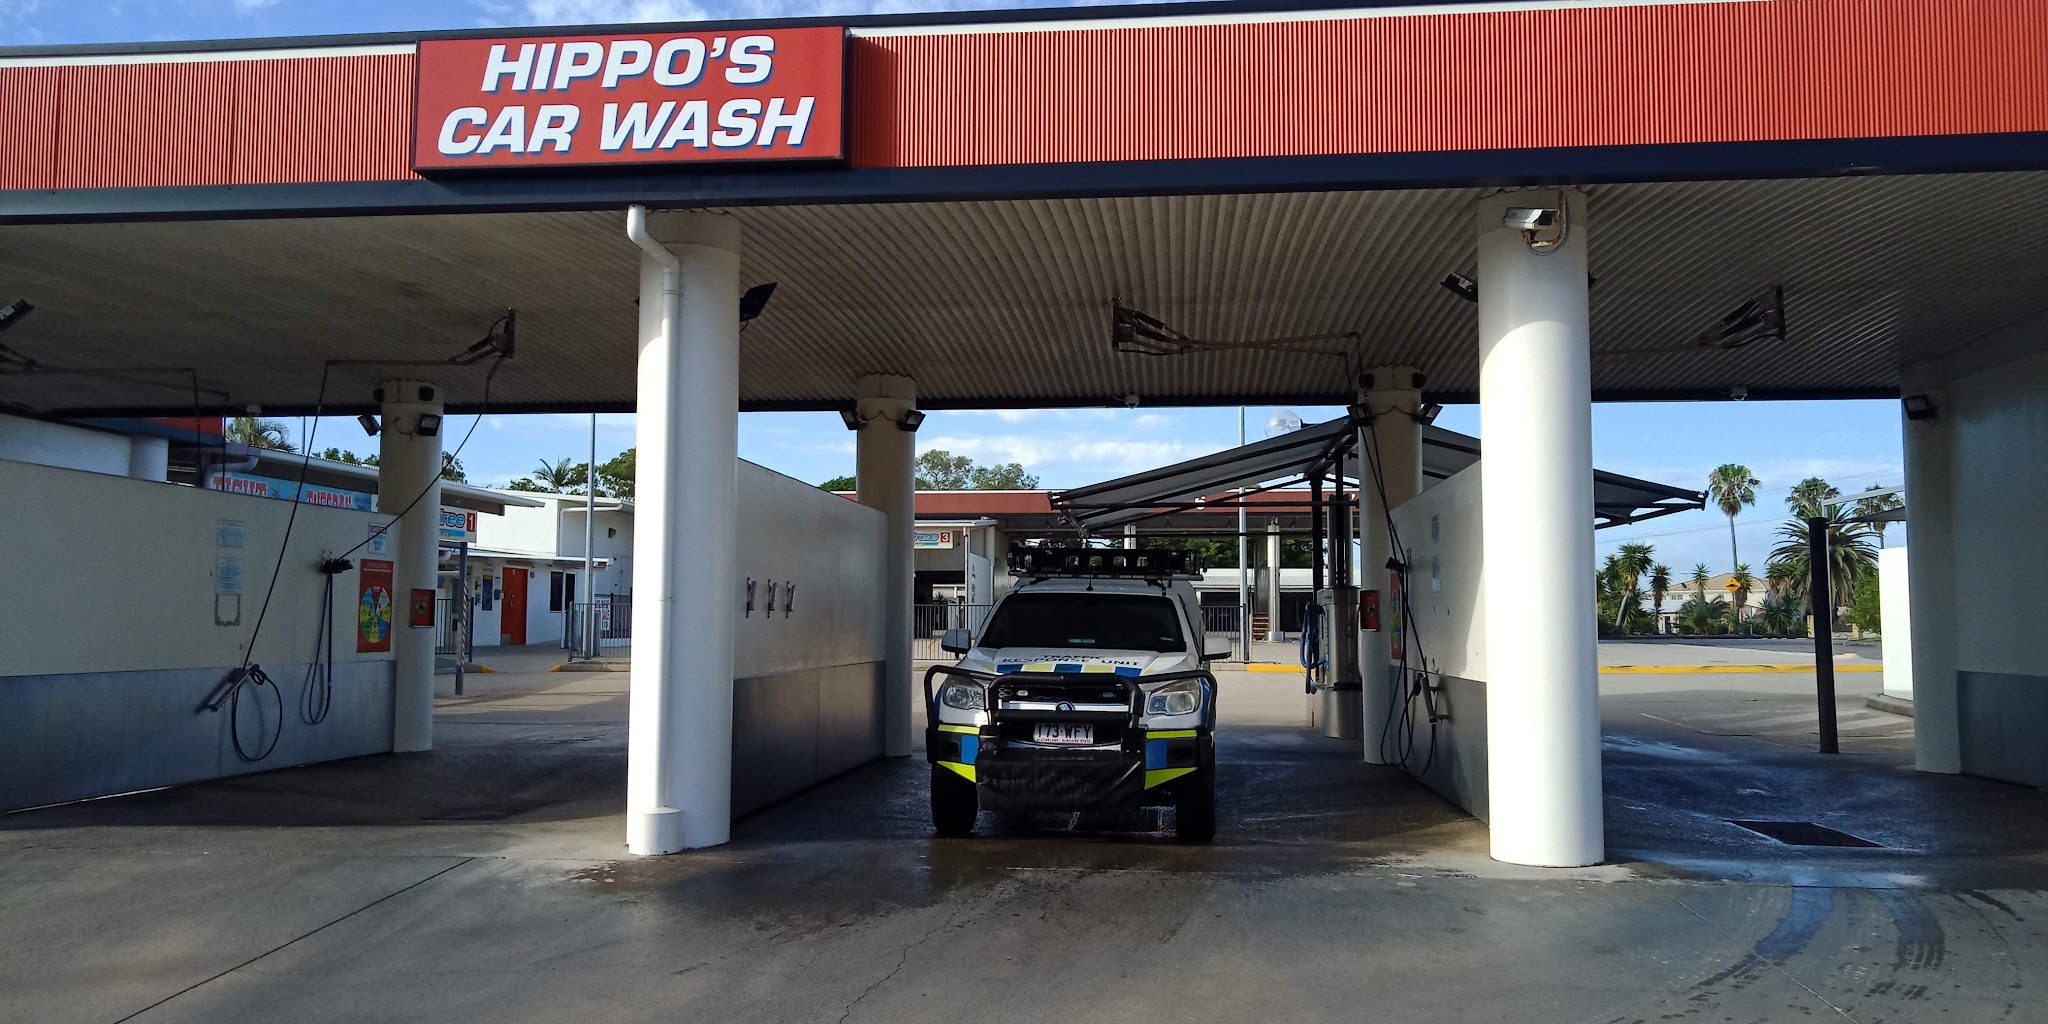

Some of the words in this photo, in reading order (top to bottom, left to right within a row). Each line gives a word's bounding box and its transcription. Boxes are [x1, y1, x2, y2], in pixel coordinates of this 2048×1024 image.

[481, 35, 775, 93] HIPPO'S
[437, 104, 580, 156] CAR
[600, 96, 815, 152] WASH
[941, 533, 949, 542] 3
